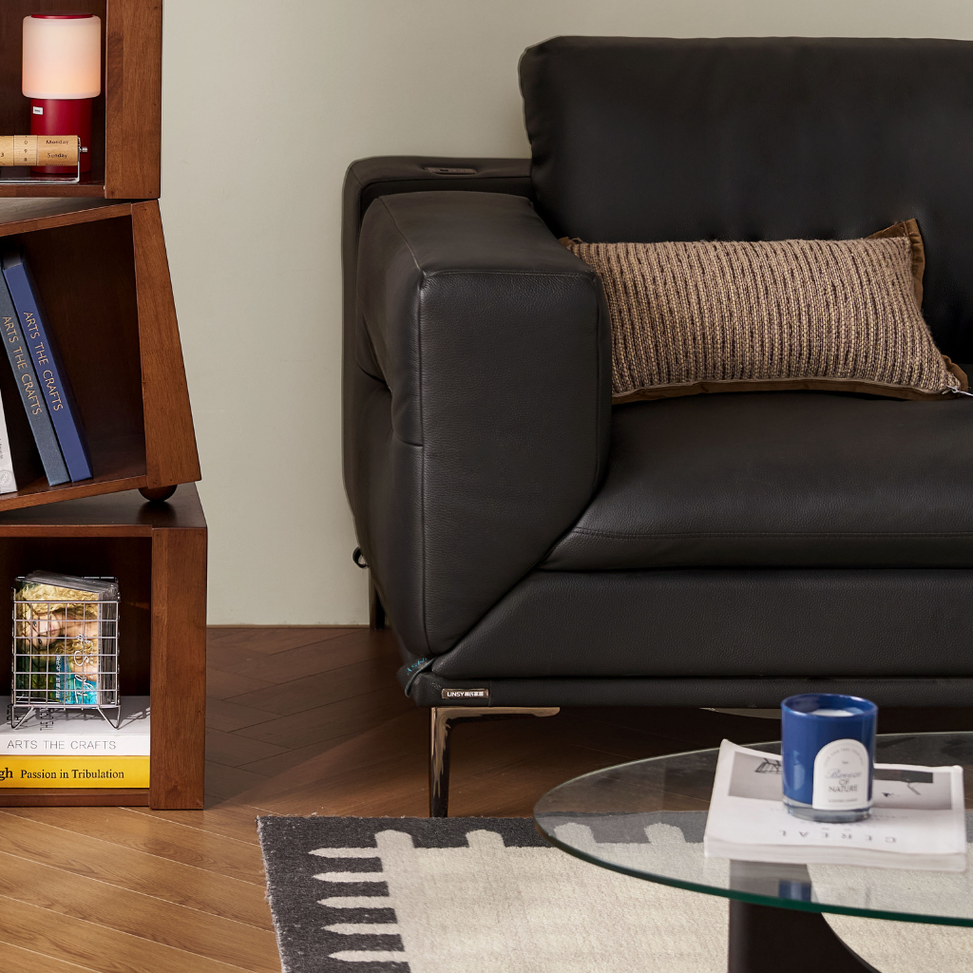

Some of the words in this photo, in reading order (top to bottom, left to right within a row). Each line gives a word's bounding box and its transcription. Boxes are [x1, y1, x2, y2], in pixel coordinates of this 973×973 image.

[2, 316, 19, 343] ARTS
[13, 346, 27, 370] THE
[21, 373, 42, 416] CRAFTS
[24, 312, 40, 339] ARTS
[34, 342, 49, 366] THE
[43, 369, 64, 412] CRAFTS
[7, 740, 38, 749] ARTS
[43, 740, 65, 750] THE
[70, 740, 116, 750] CRAFTS
[20, 769, 57, 779] Passion
[60, 769, 69, 779] in
[71, 769, 125, 779] Tribulation
[828, 784, 858, 792] NATURE
[778, 830, 897, 844] CEREAL
